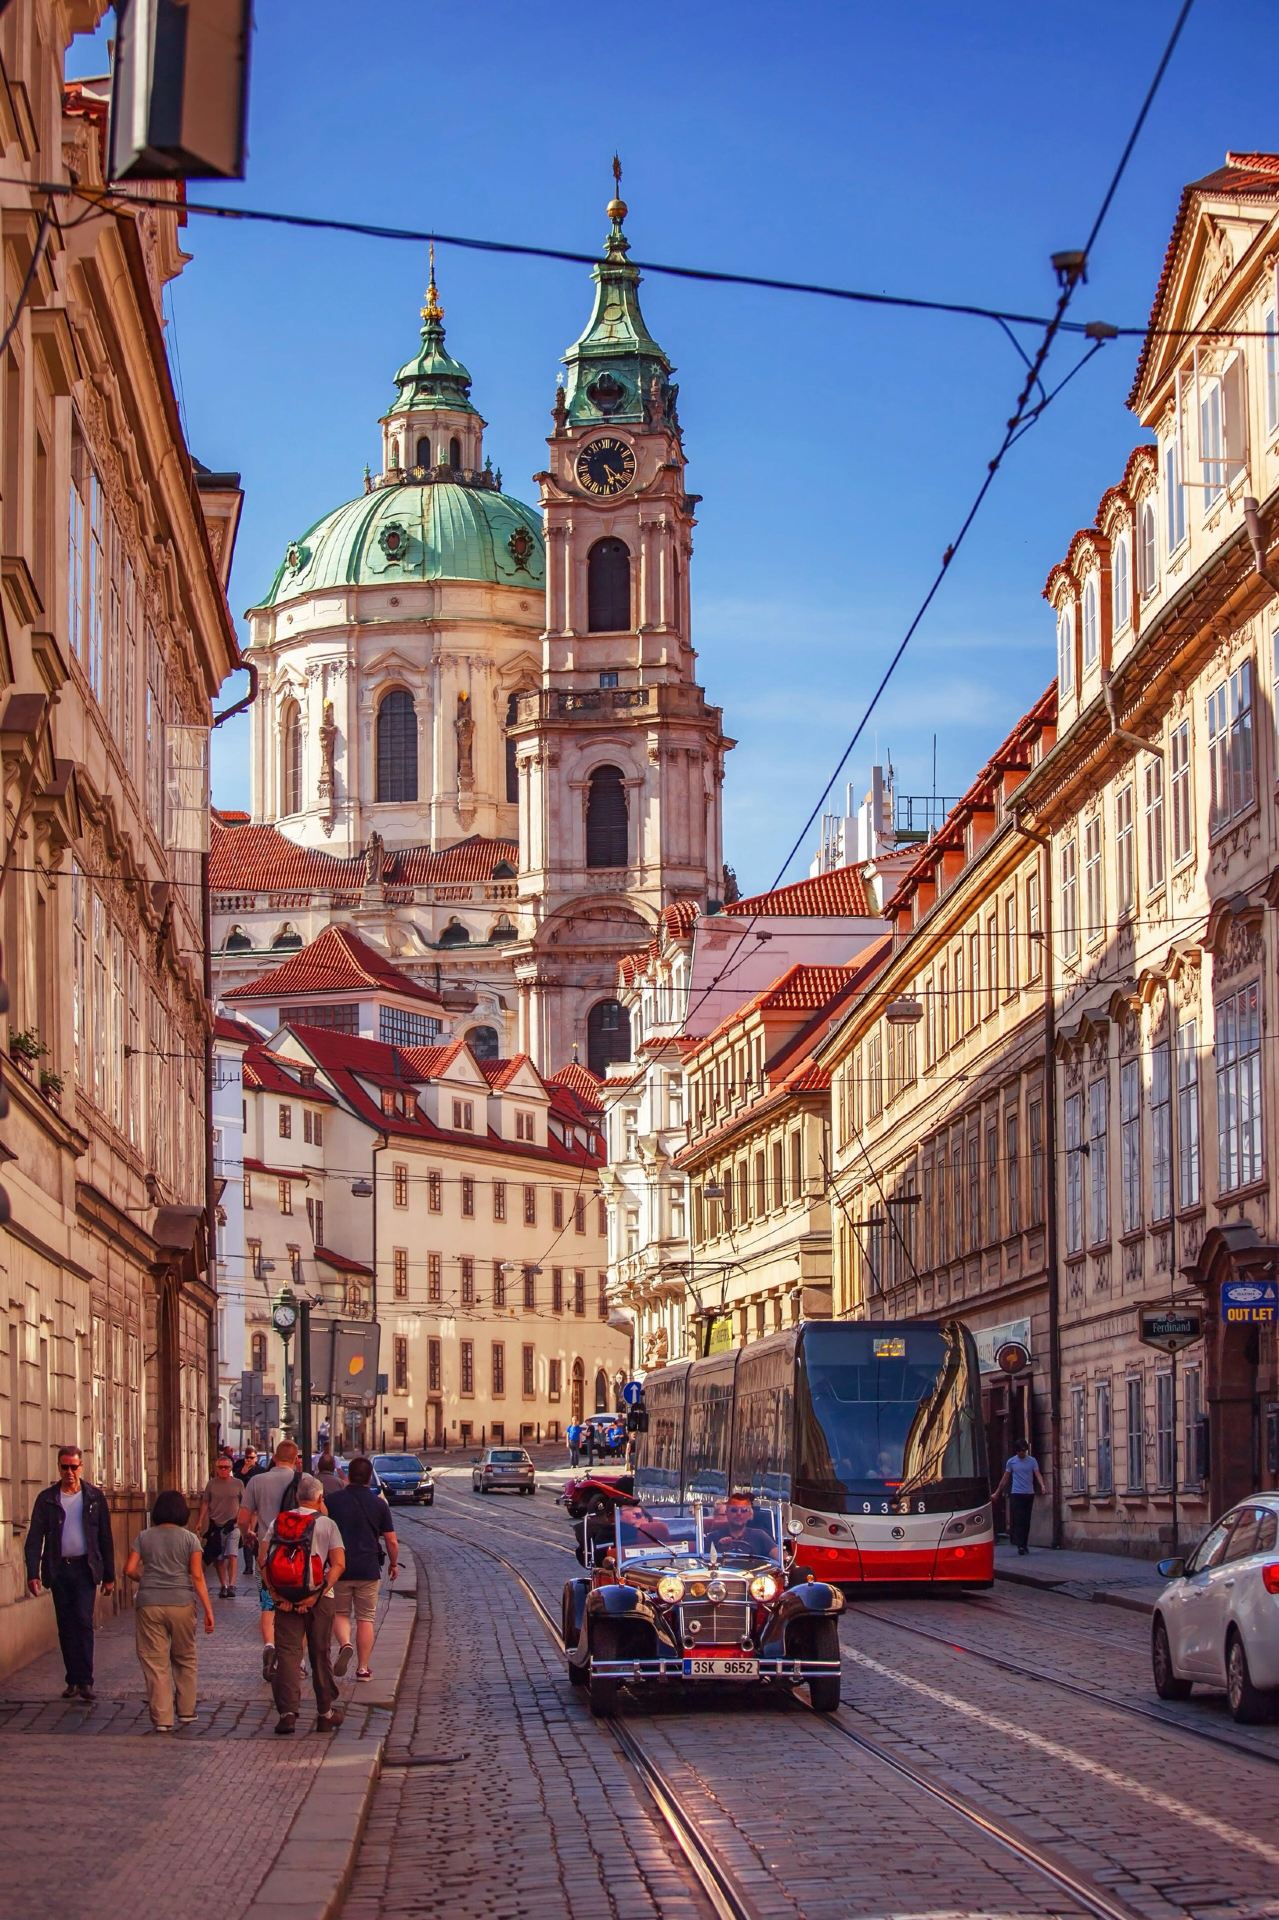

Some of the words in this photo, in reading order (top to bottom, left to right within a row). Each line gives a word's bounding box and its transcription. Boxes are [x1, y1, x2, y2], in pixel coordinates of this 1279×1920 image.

[1227, 1308, 1250, 1321] OUT
[1252, 1308, 1274, 1321] LET
[1152, 1321, 1191, 1333] Ferdinand
[862, 1501, 926, 1514] 9338
[694, 1662, 715, 1674] 3SK
[724, 1662, 753, 1674] 9652
